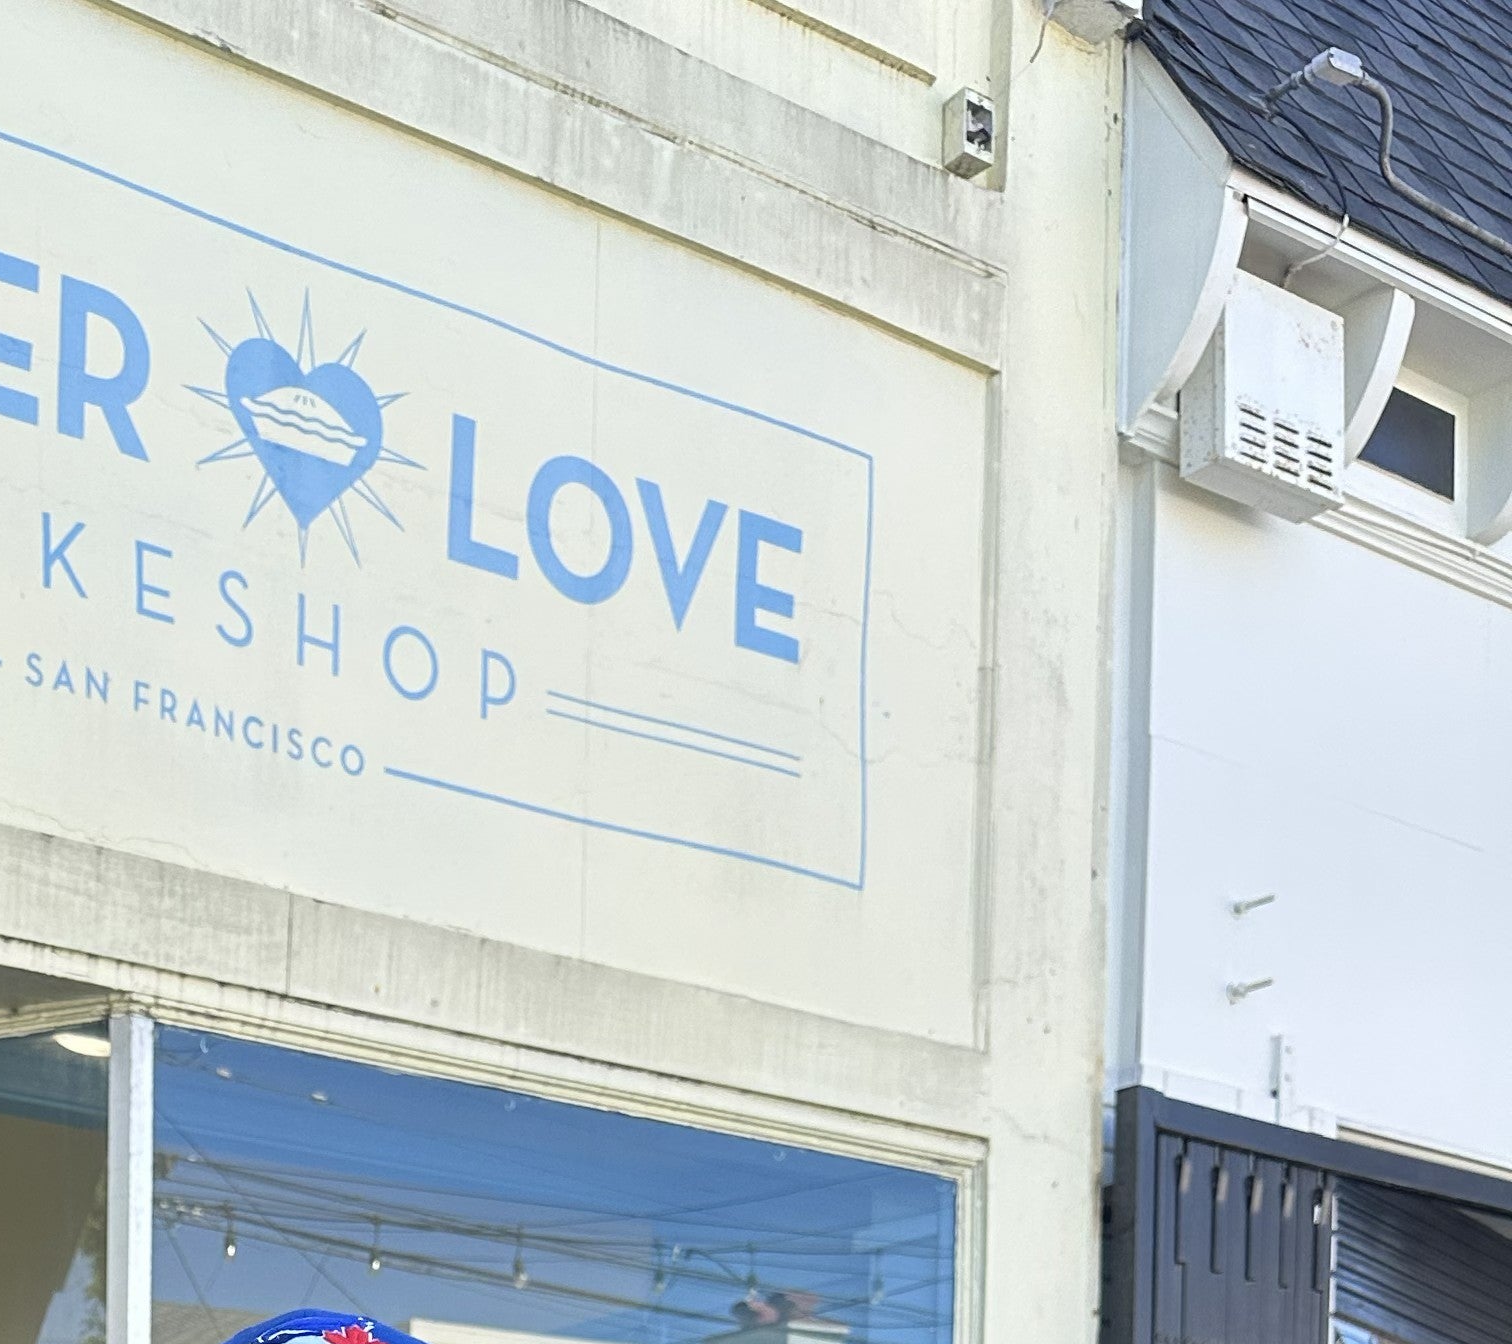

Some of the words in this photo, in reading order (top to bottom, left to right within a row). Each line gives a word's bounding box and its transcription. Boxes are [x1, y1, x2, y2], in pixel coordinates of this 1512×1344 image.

[448, 414, 804, 664] LOVE
[25, 651, 110, 704] SAN
[133, 679, 365, 777] FRANCISCO
